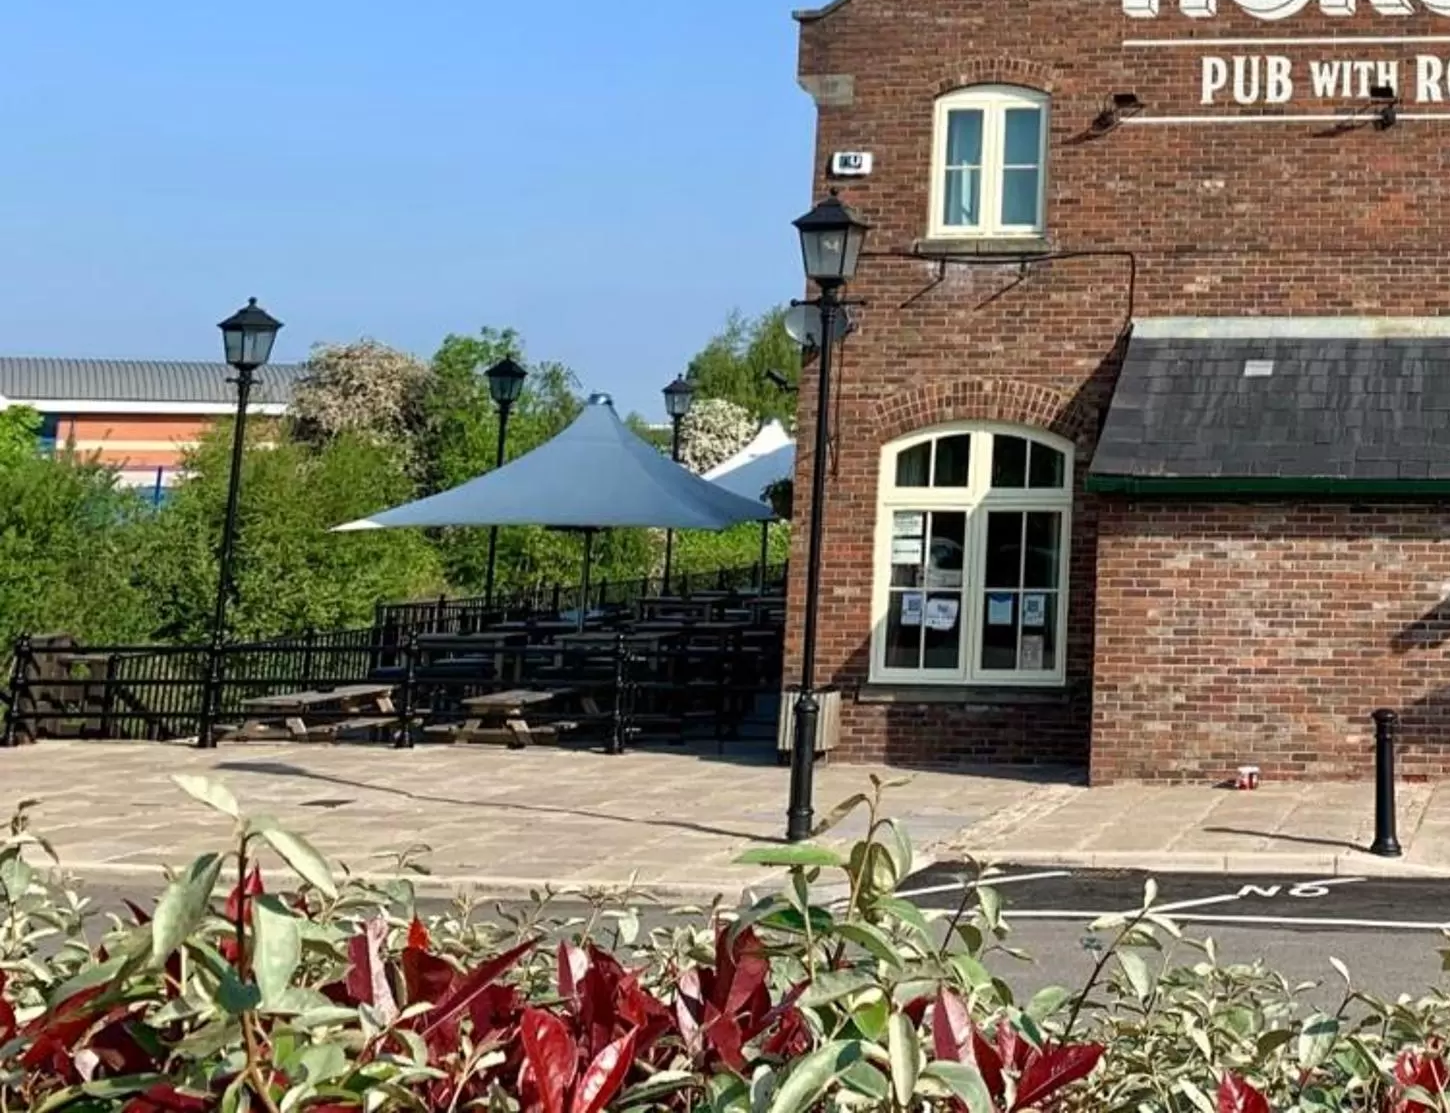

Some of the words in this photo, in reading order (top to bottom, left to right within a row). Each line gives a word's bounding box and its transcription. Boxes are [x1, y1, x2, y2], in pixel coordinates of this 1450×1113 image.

[1200, 55, 1293, 105] PUB
[1309, 60, 1399, 98] WITH
[1237, 884, 1329, 897] NO
